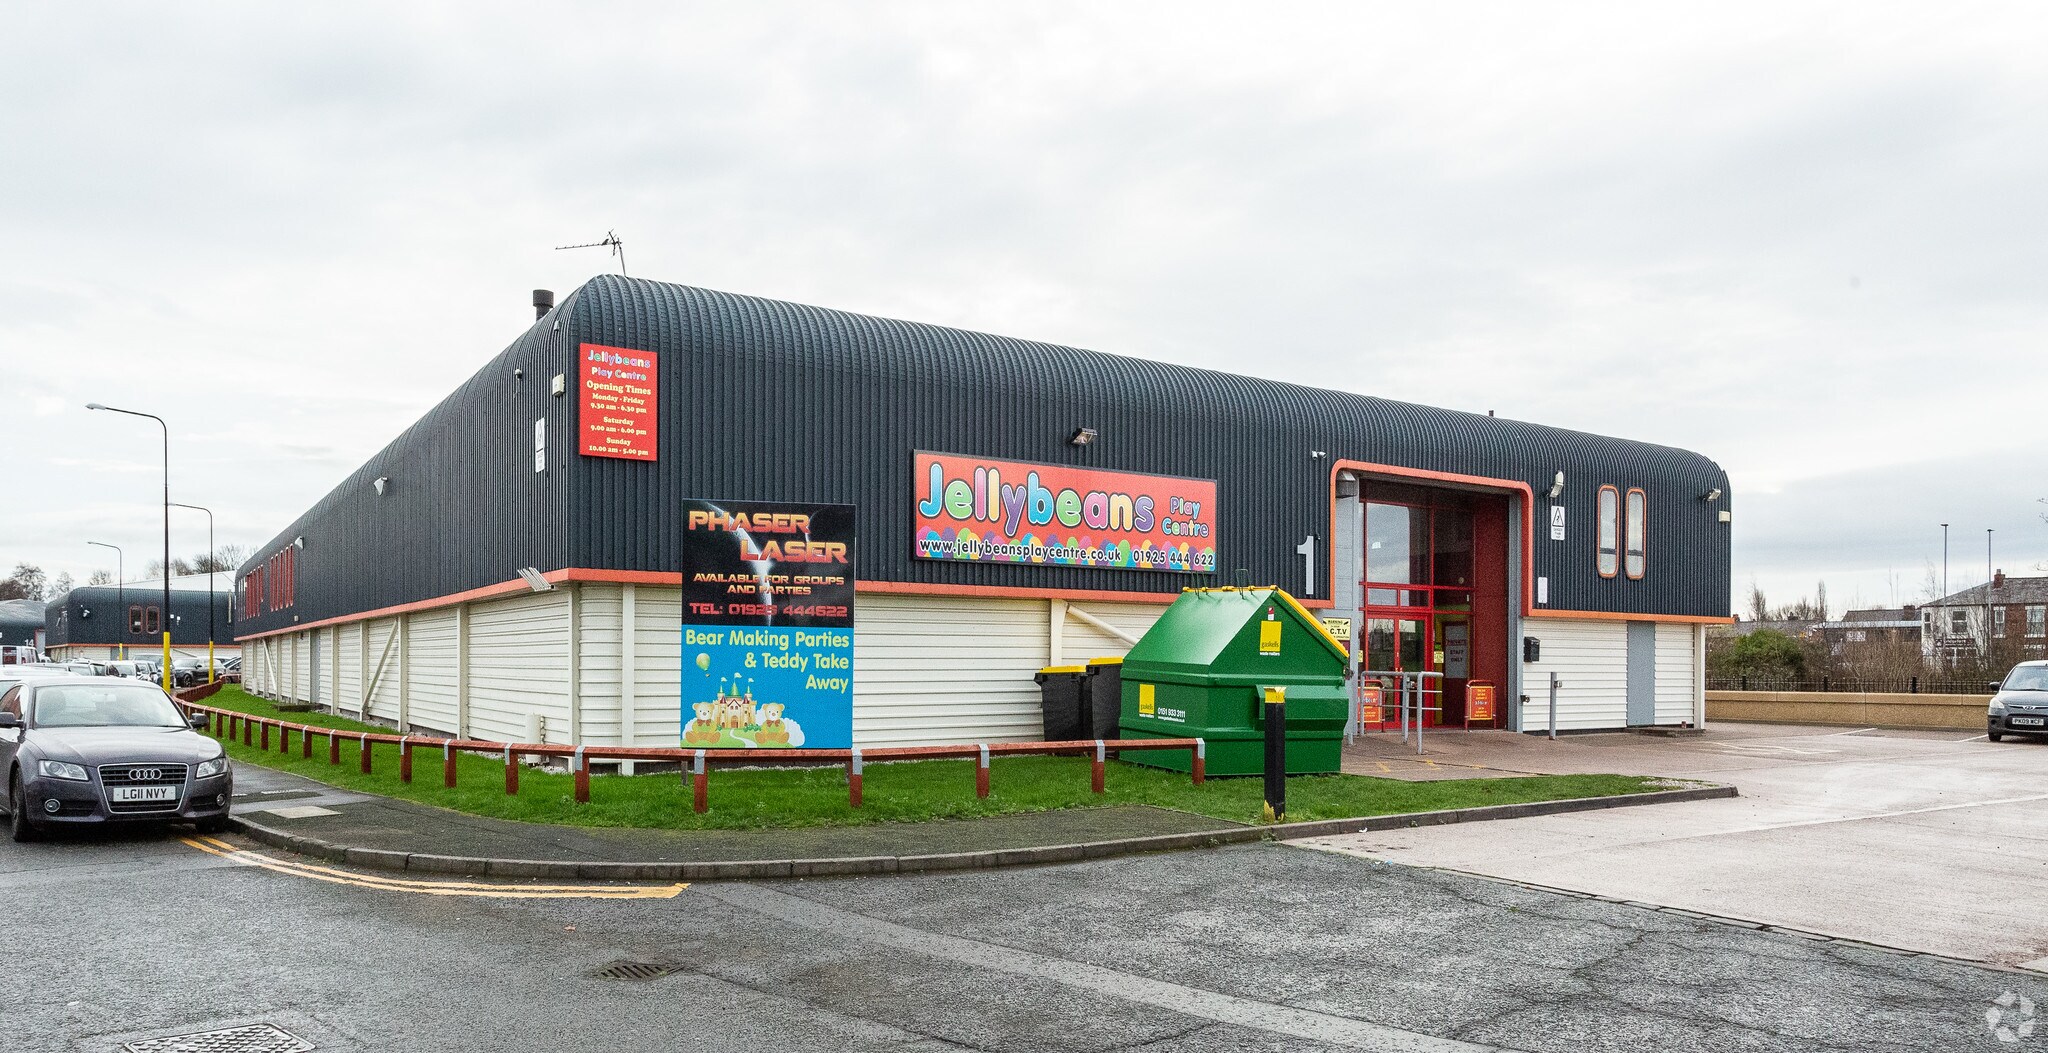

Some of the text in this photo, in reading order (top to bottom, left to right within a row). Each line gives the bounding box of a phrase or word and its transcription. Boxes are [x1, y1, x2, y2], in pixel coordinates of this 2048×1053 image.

[588, 350, 650, 368] Jellybeans
[591, 367, 646, 381] Play Centre
[586, 380, 651, 395] Opening Times
[592, 393, 618, 402] Monday
[623, 396, 645, 405] Friday
[603, 417, 634, 426] Saturday
[606, 437, 631, 446] Sunday
[918, 461, 1155, 538] Jellybeans
[1170, 496, 1200, 519] Play
[688, 511, 811, 534] PHASER
[1162, 517, 1209, 538] Centre
[740, 540, 849, 563] LASER
[919, 539, 1121, 562] www.jellybeansplaycentre.co.uk
[1133, 550, 1214, 565] 01925 444 622
[1297, 536, 1314, 595] 1
[693, 573, 844, 586] AVAILABLE FOR GROUPS
[727, 585, 811, 595] AND PARTIES
[689, 603, 848, 617] TEL: 01925 444622
[25, 639, 34, 648] 14
[686, 629, 849, 651] Bear Making Parties
[744, 652, 849, 672] & Teddy Take
[805, 674, 849, 694] Away
[1158, 707, 1167, 715] 0151
[123, 788, 167, 799] LG11 NVY
